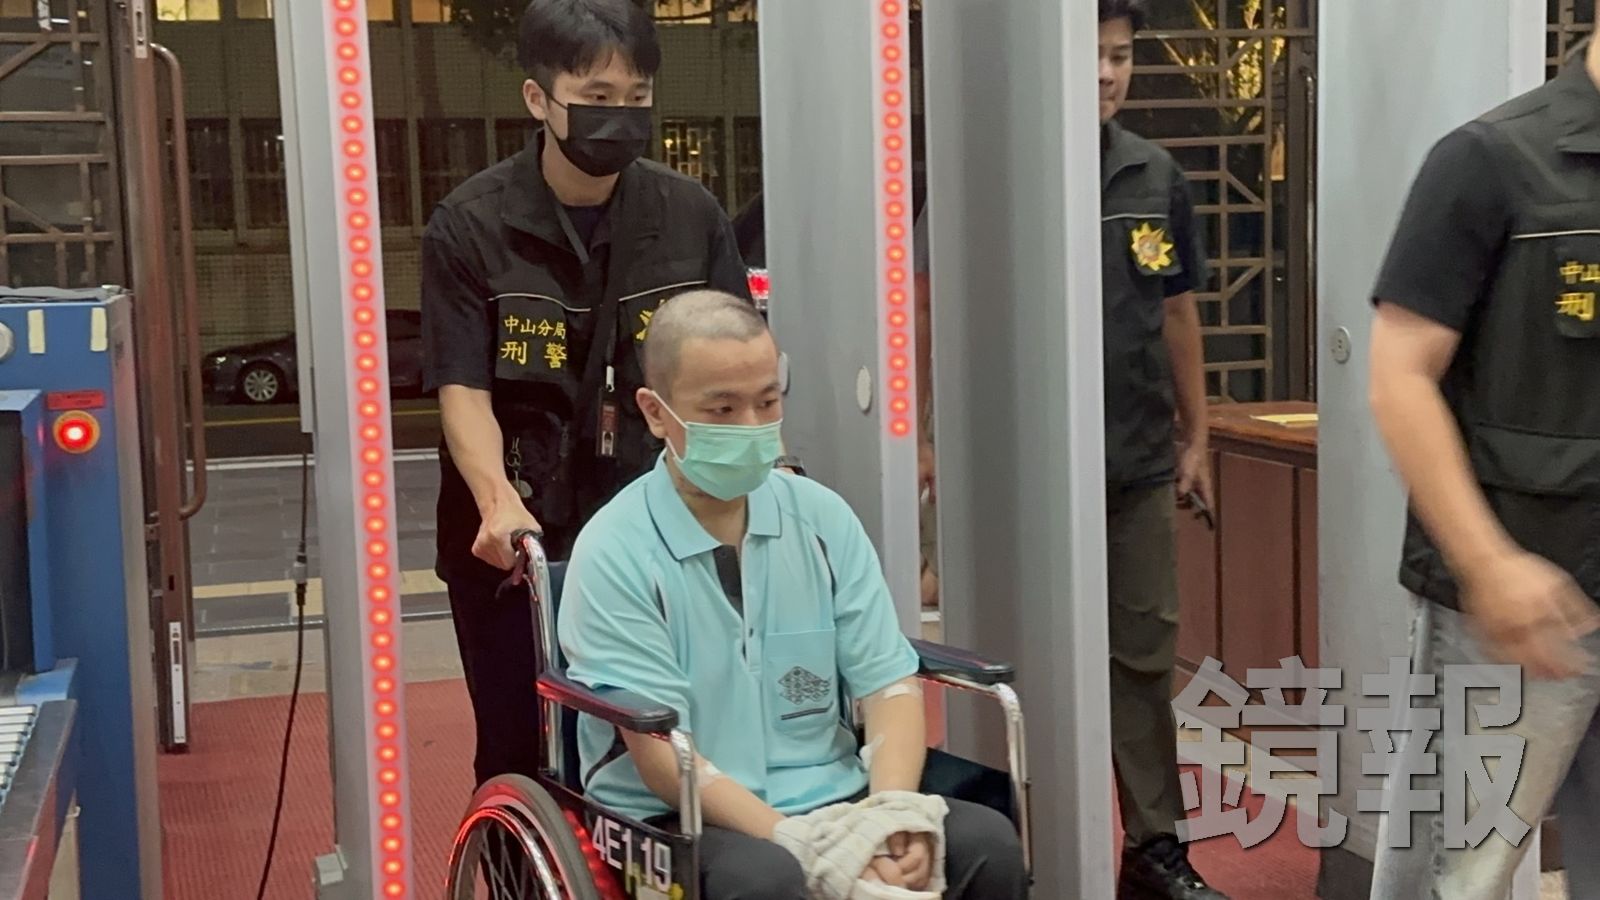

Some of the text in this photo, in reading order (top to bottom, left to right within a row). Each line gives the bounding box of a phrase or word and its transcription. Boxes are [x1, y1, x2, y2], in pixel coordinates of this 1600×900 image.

[1555, 292, 1595, 321] 刑
[504, 315, 566, 340] 中山分局
